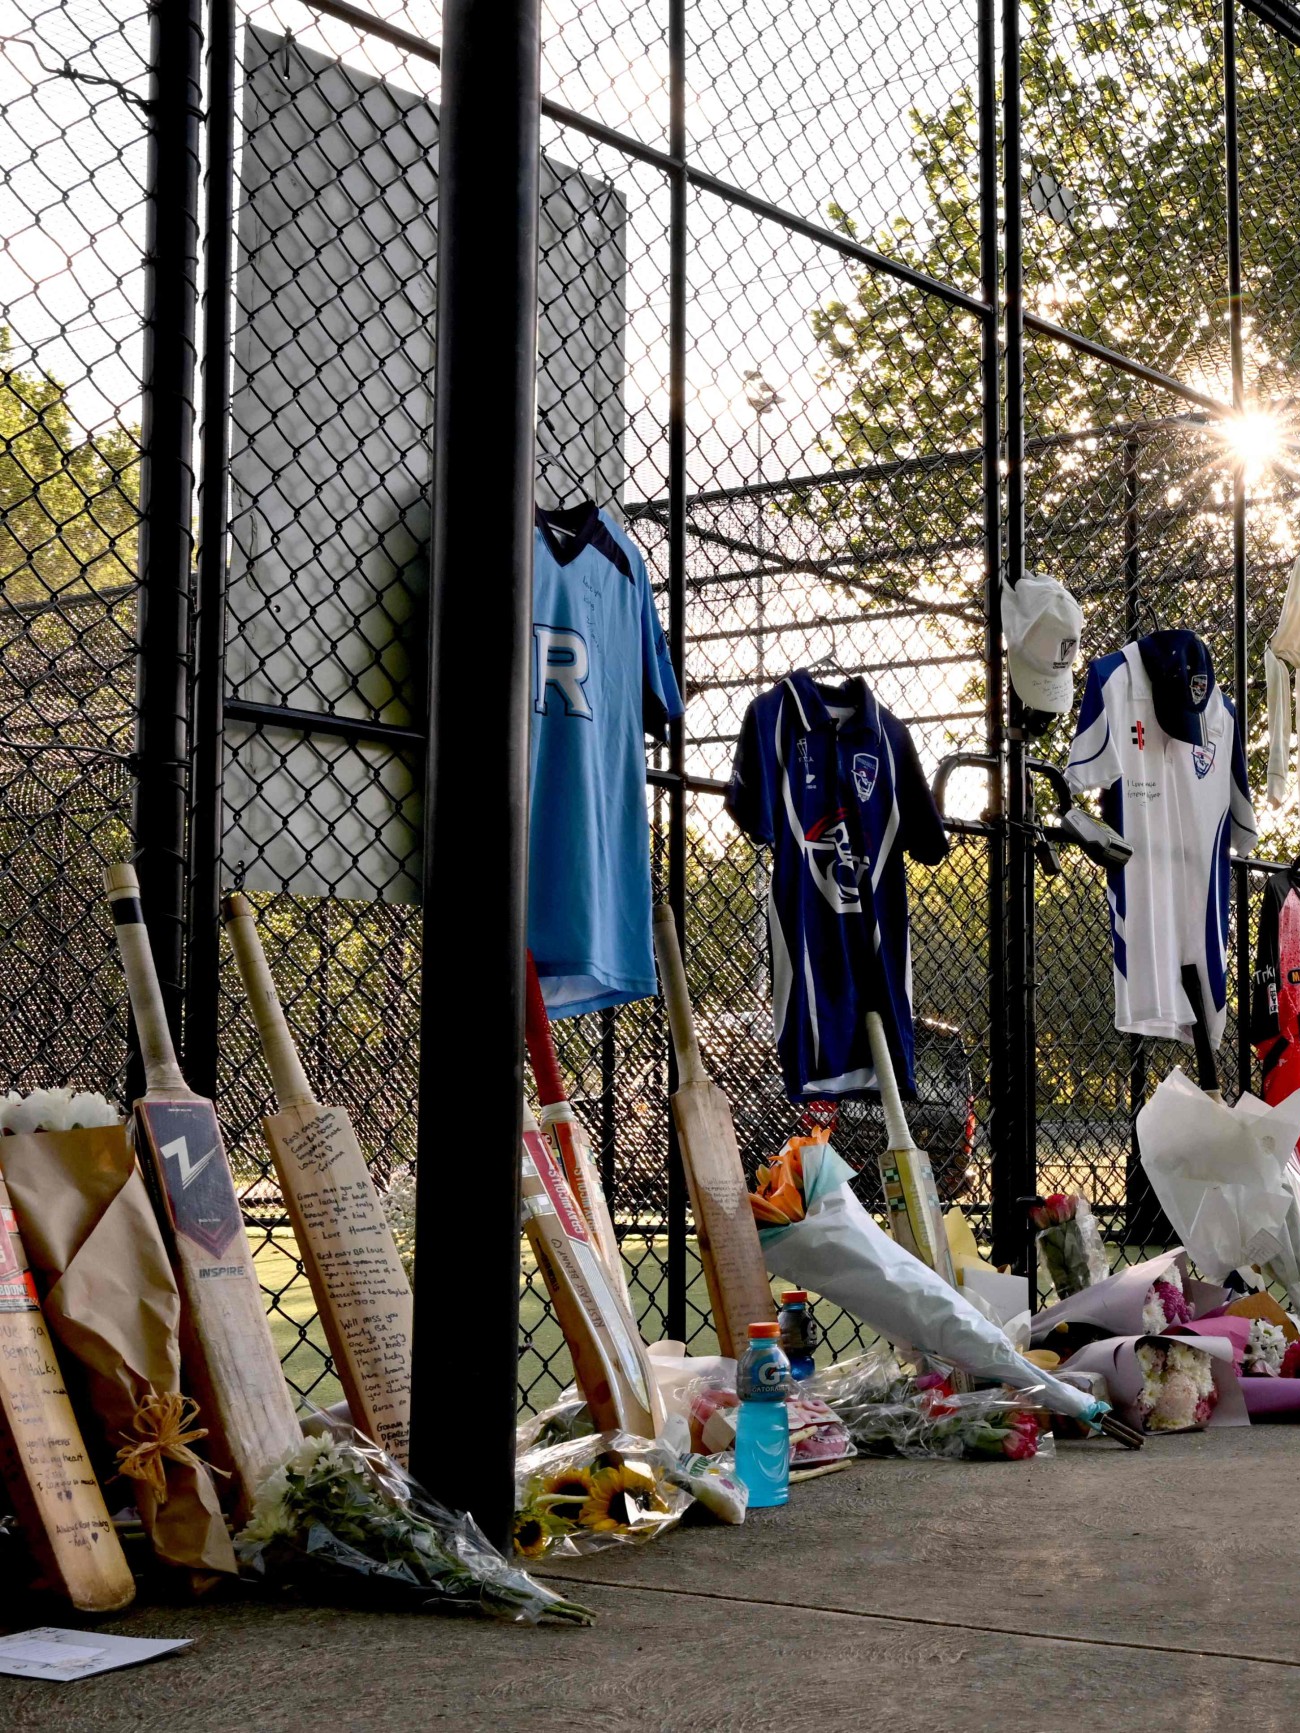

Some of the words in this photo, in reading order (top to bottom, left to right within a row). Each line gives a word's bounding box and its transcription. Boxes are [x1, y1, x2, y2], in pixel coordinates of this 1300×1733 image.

[533, 624, 593, 721] R
[199, 1265, 245, 1279] INSPIRE
[758, 1362, 781, 1386] G
[63, 1452, 84, 1462] heart
